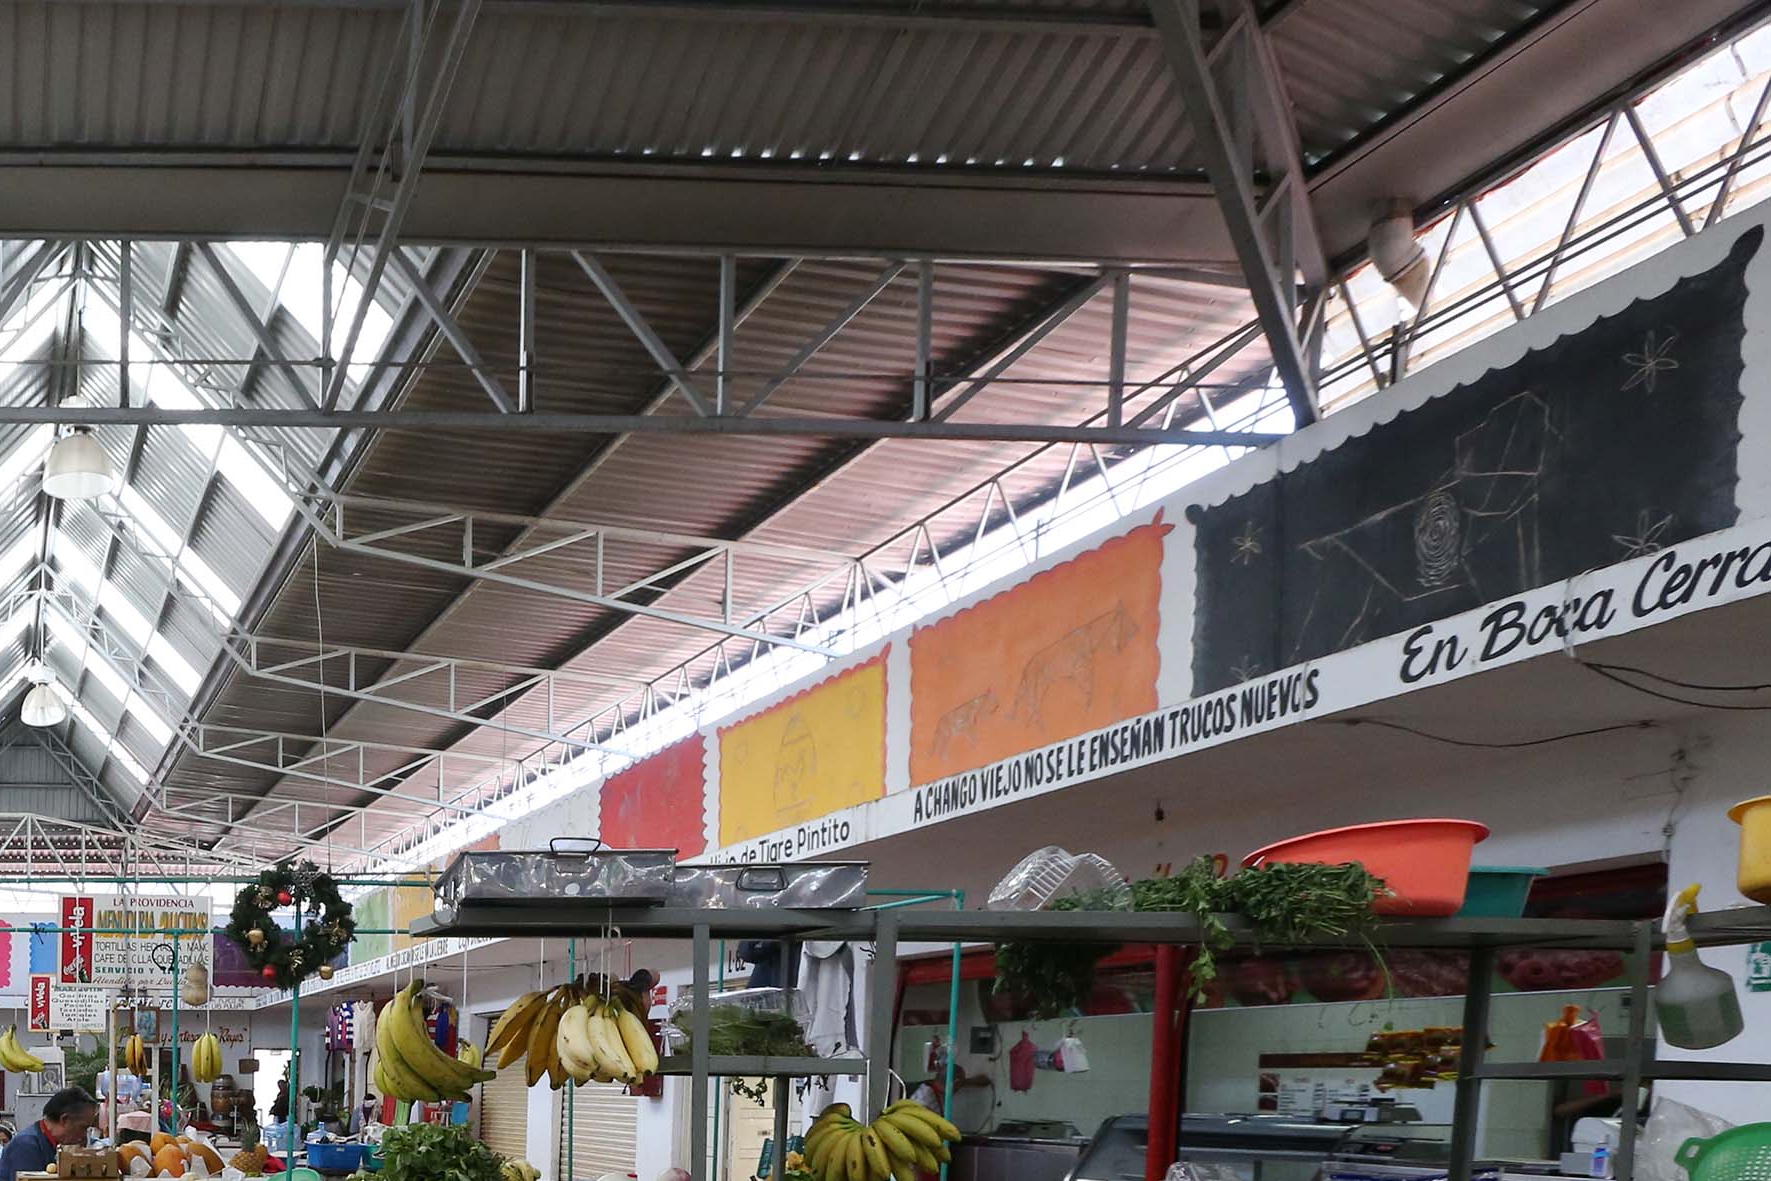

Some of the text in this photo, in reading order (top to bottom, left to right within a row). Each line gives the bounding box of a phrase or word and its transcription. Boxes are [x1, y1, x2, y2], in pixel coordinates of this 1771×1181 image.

[1400, 625, 1467, 684] En
[1480, 589, 1616, 662] Boca
[913, 668, 1320, 824] A CHANGO VIEJO NO SE LE ENSEÑAN TRUCOS NUEVOS
[759, 840, 793, 863] Tigre
[797, 819, 851, 854] Pintito
[113, 898, 195, 908] LA PROVIDENCIA
[95, 942, 138, 951] TORTILLAS
[141, 942, 171, 951] HECAS
[94, 953, 115, 963] CAFE
[117, 953, 128, 963] DE
[138, 978, 154, 986] por
